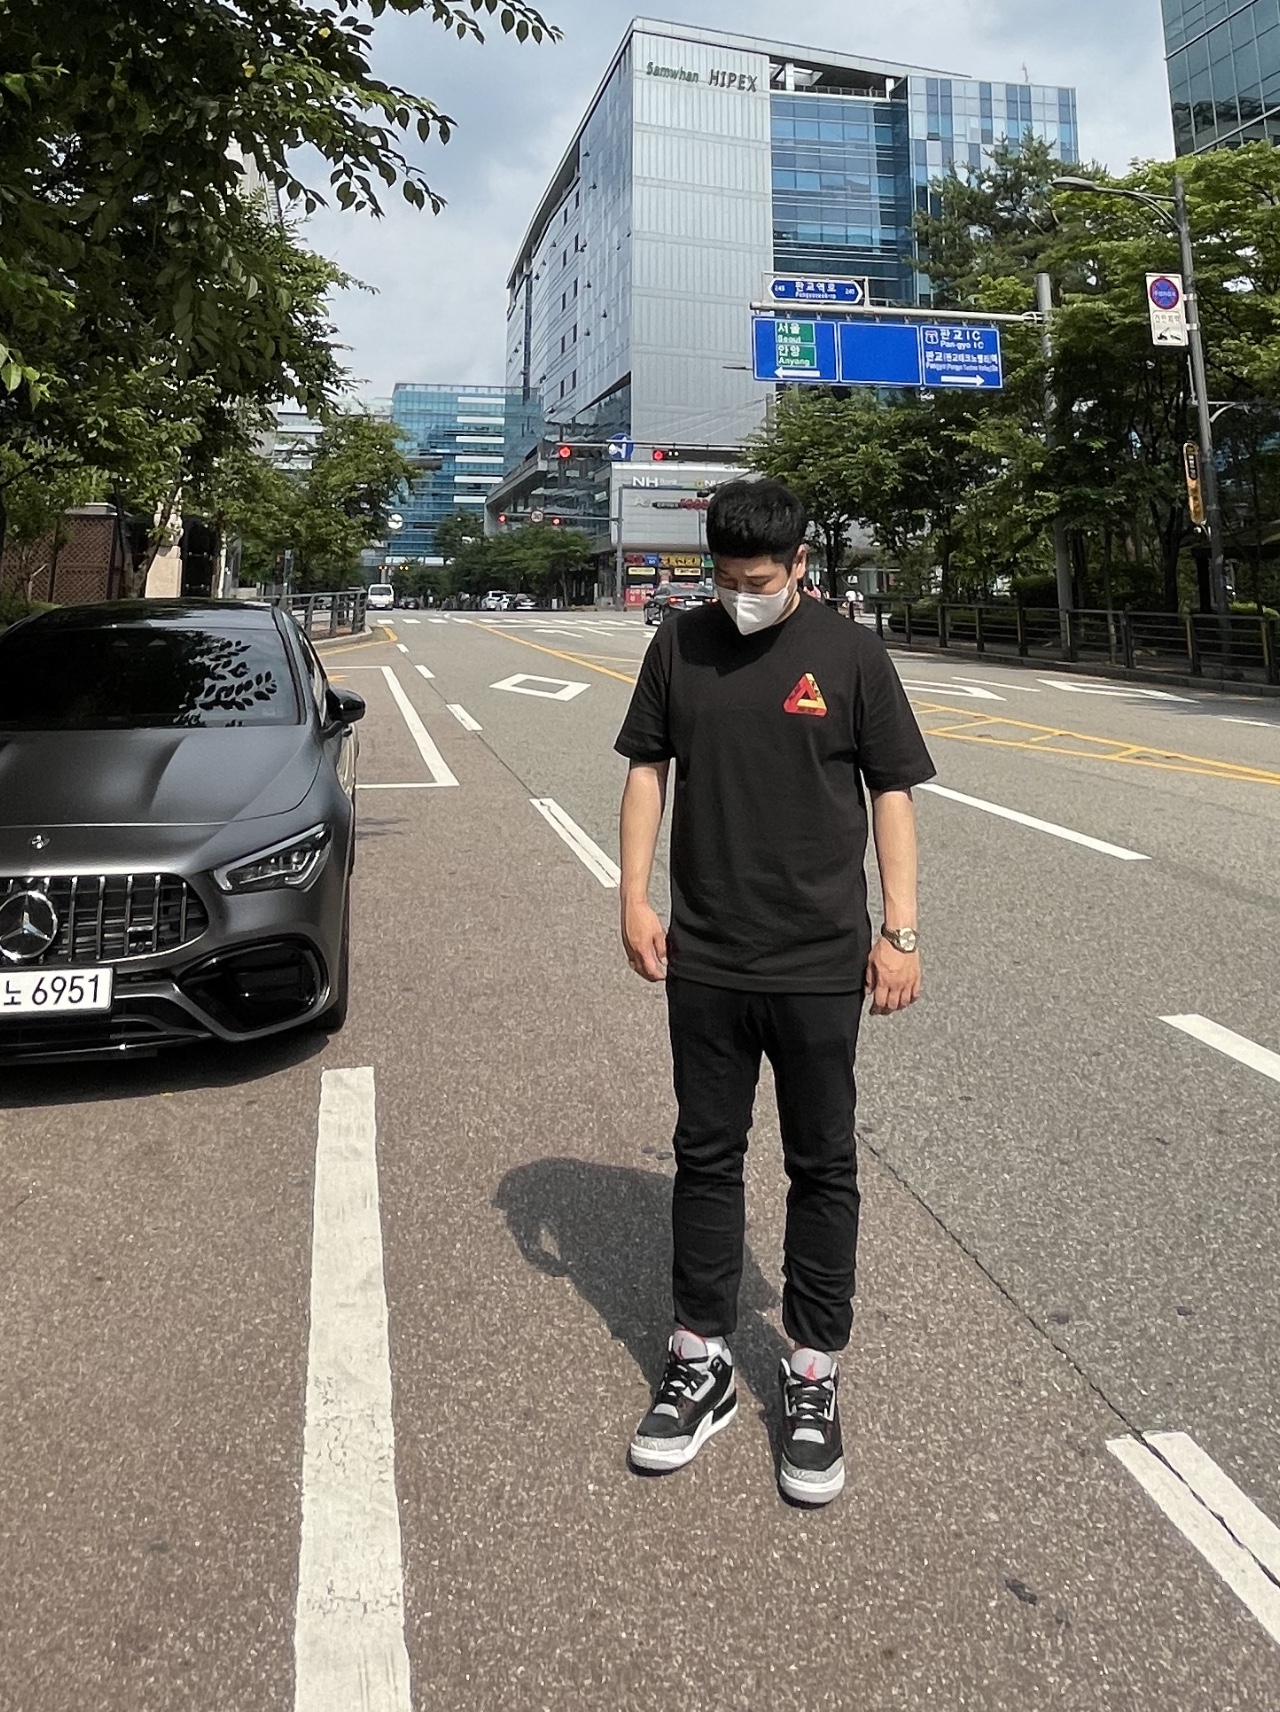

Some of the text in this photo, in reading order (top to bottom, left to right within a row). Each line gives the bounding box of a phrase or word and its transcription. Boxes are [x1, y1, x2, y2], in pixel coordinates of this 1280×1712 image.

[646, 61, 757, 92] Samwhan HIPEX
[795, 281, 836, 293] 판교역로
[778, 322, 800, 334] 서울
[778, 334, 801, 343] Seoul
[778, 345, 800, 357] 안양
[940, 340, 985, 350] Pan-gyo IC
[779, 357, 810, 367] Anyang
[632, 475, 658, 487] NH
[3, 974, 99, 1006] 노 6951
